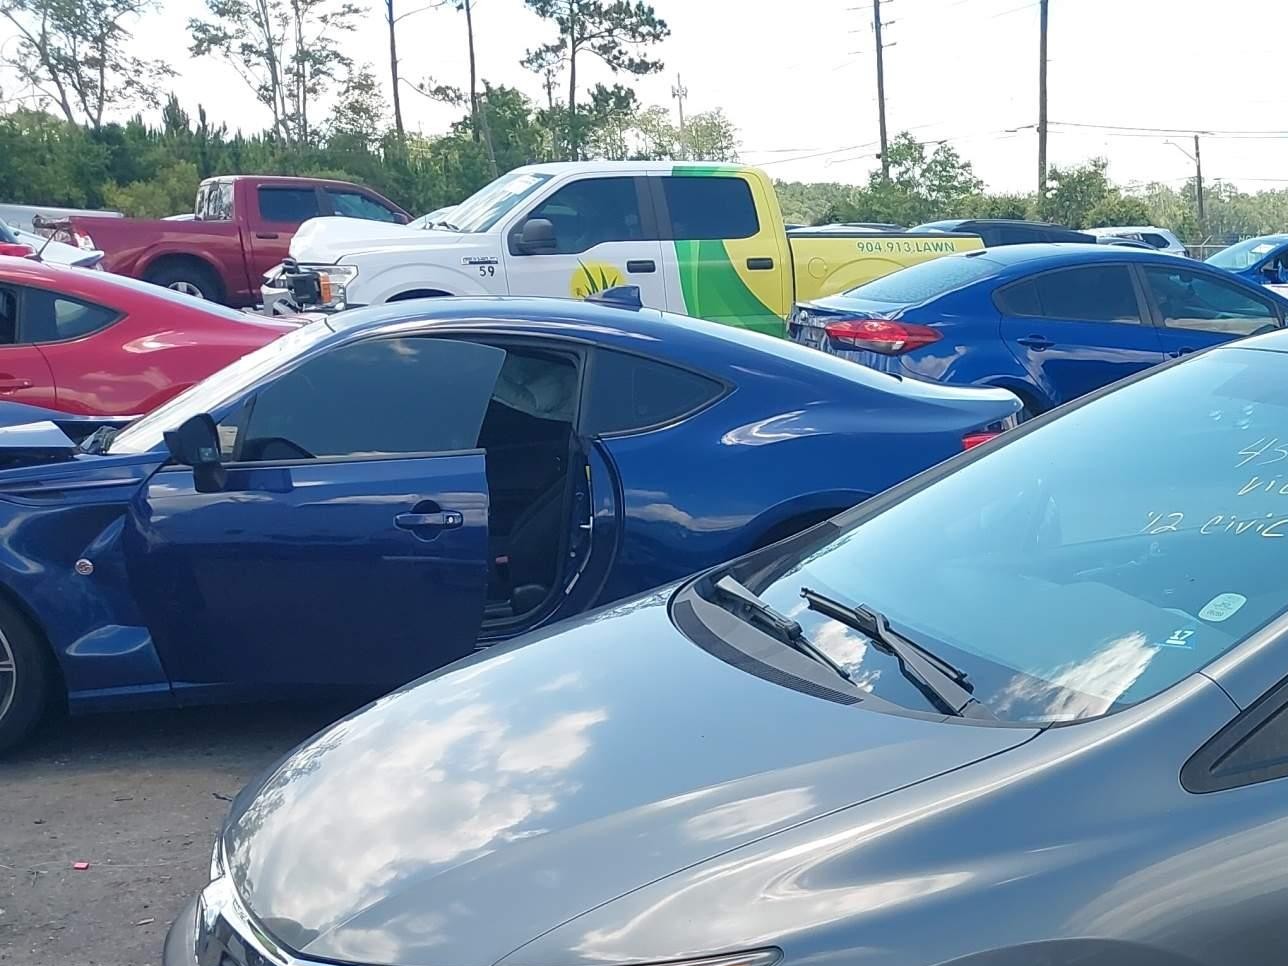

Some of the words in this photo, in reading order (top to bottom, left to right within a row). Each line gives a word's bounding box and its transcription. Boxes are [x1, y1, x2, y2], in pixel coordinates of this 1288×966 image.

[857, 241, 955, 253] 904.913.LAWN
[479, 265, 495, 277] 59
[1169, 629, 1195, 641] 17
